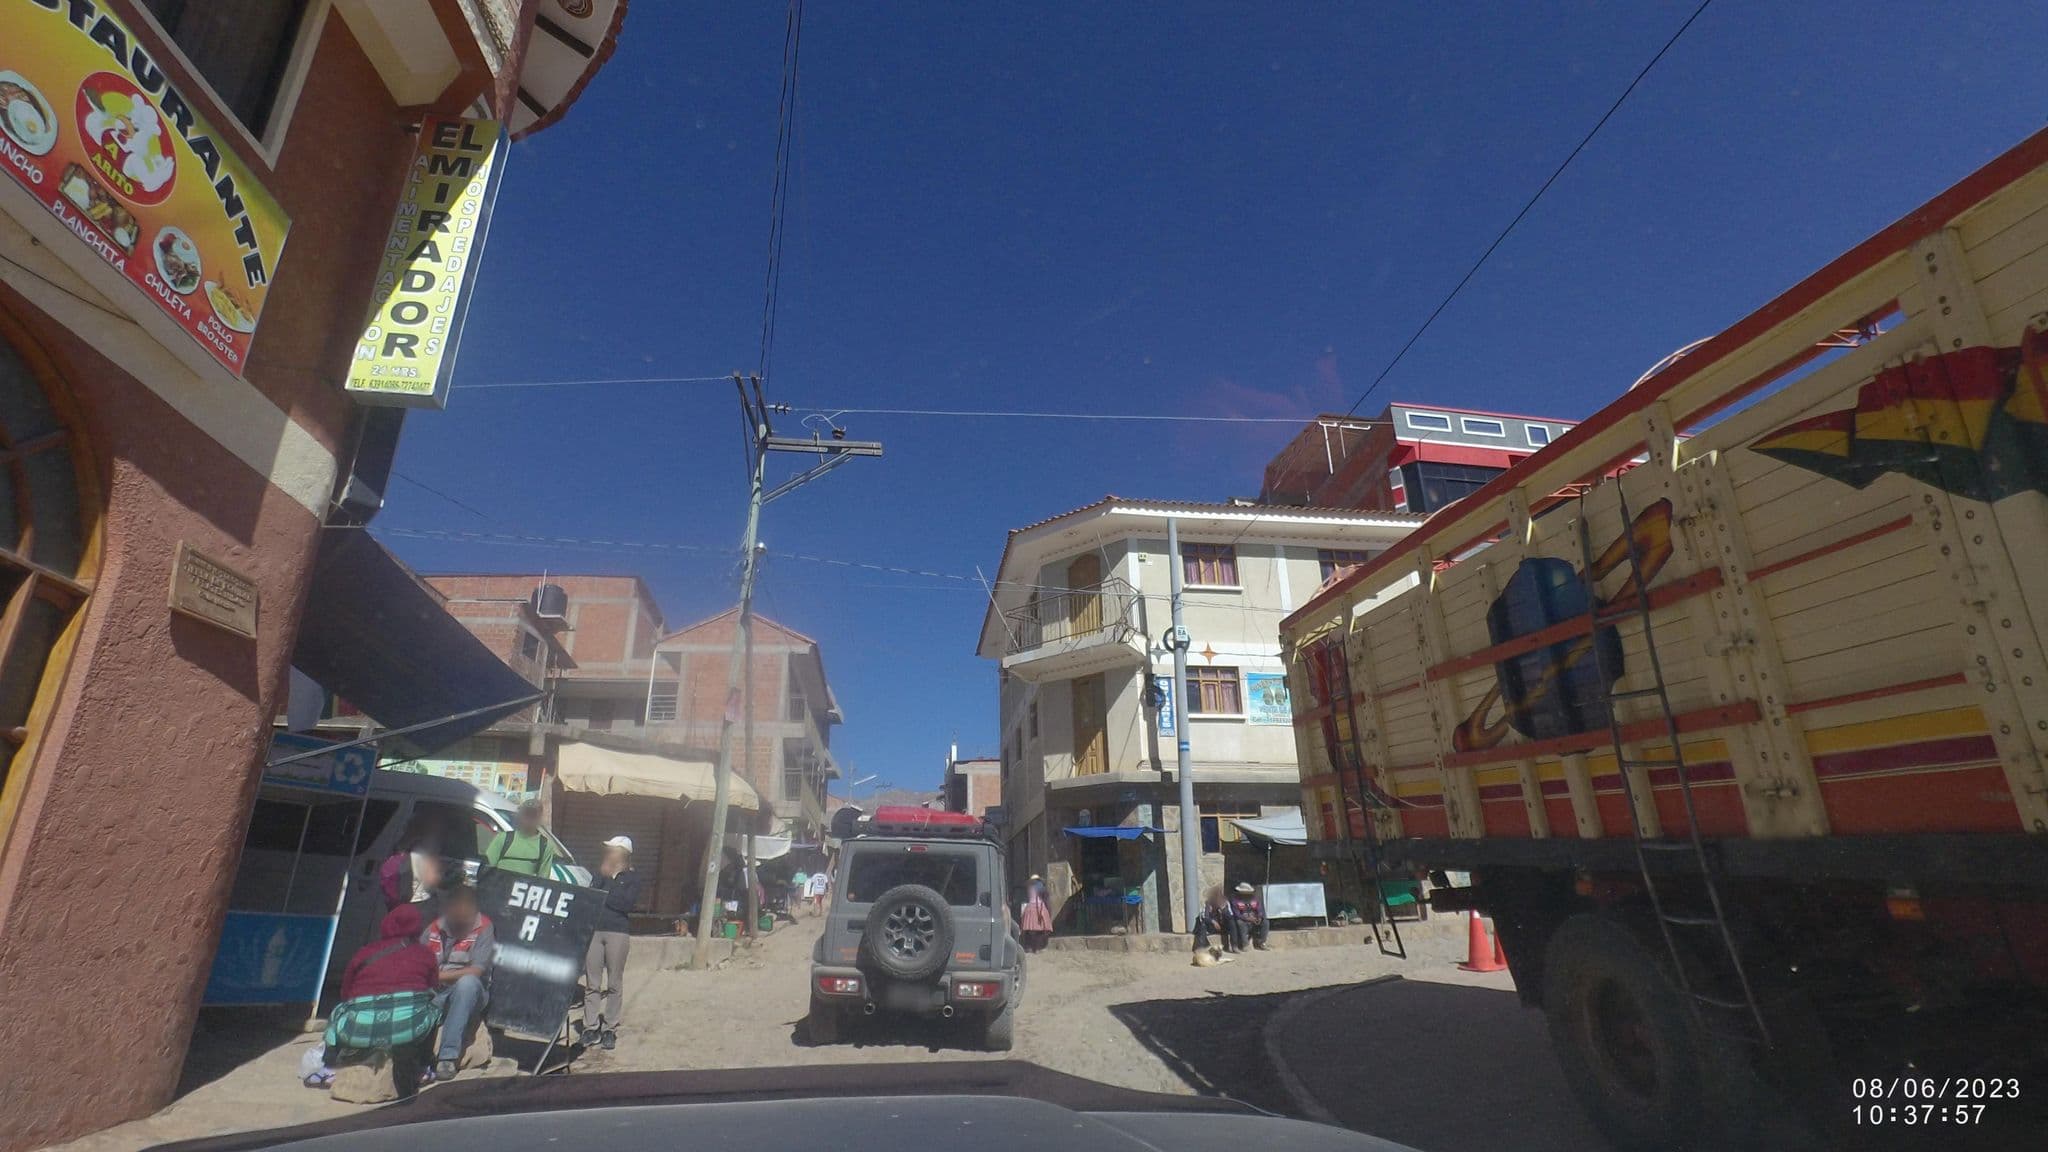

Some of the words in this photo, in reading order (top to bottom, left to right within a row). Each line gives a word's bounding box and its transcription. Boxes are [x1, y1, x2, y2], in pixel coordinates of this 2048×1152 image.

[32, 0, 268, 288] TAURANTE
[431, 124, 483, 151] EL
[53, 200, 125, 271] PLANCHITA
[356, 154, 430, 361] ALIMENTACION
[381, 154, 472, 359] MIRADOR
[424, 164, 487, 356] HOSPEDAJES
[145, 273, 192, 320] CHULETA
[207, 316, 233, 343] POLLO
[508, 881, 575, 919] SALE
[518, 915, 540, 942] A
